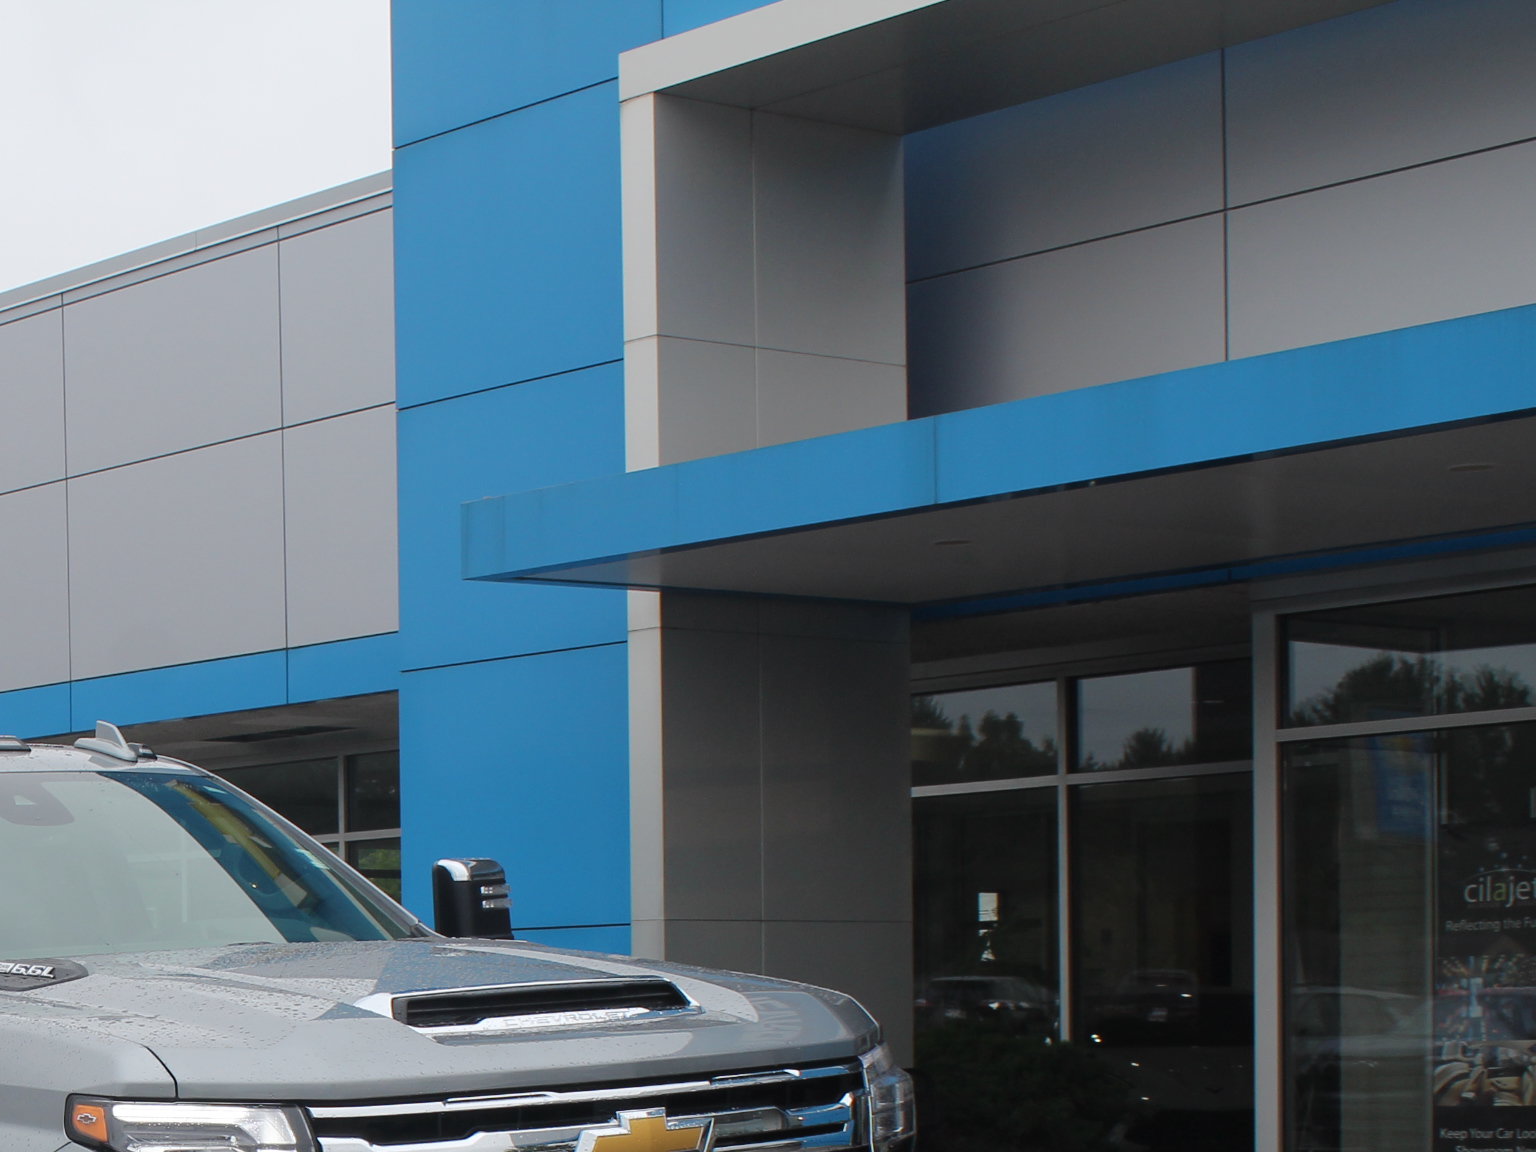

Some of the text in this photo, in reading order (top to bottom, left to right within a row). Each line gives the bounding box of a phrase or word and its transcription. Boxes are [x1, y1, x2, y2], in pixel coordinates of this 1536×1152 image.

[503, 1008, 632, 1028] CHEVROLET
[1439, 1128, 1468, 1141] Keep
[1469, 1128, 1494, 1139] Your
[1495, 1128, 1514, 1139] Car
